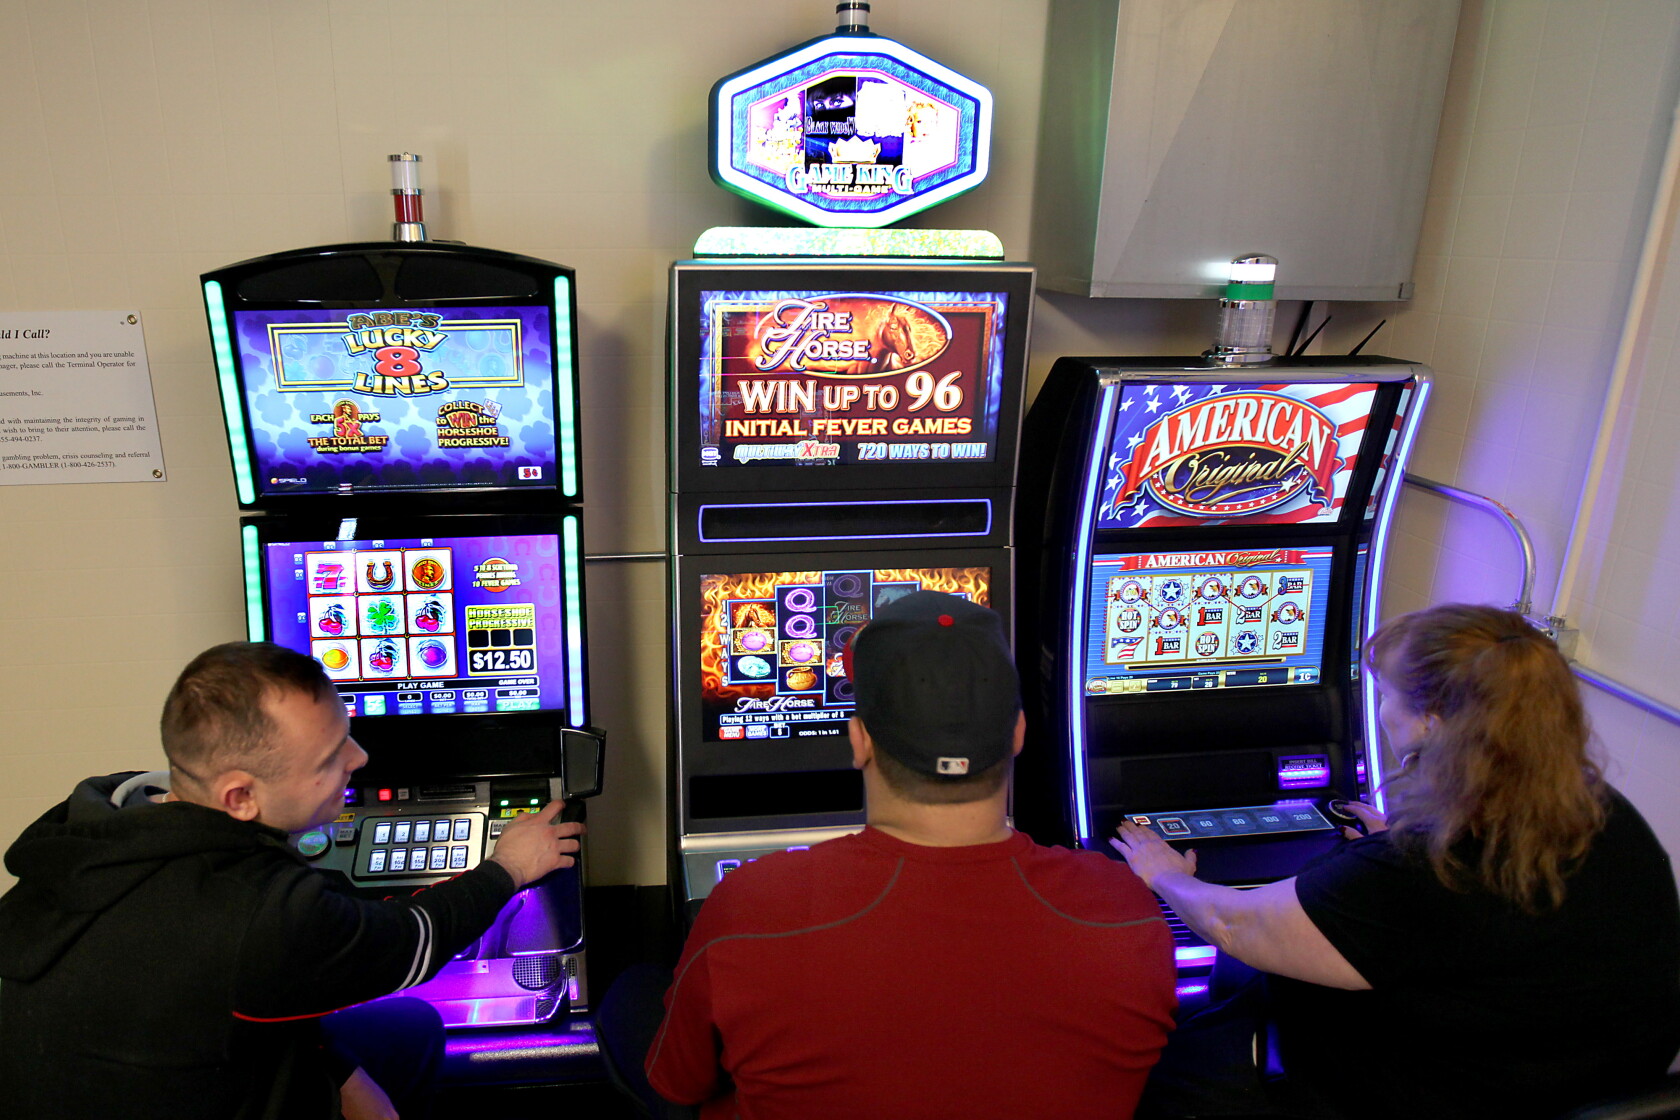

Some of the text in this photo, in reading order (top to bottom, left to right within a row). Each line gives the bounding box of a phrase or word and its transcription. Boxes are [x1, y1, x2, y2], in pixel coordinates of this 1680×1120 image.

[786, 163, 914, 194] GAME KING
[350, 312, 441, 330] ABE'S
[773, 298, 852, 334] FIRE
[0, 329, 50, 340] ld I Call?
[345, 328, 448, 353] LUCKY
[2, 352, 29, 360] machine
[50, 351, 76, 359] location
[113, 350, 135, 358] unable
[755, 327, 871, 371] HORSE
[19, 362, 40, 370] please
[96, 360, 125, 369] Operator
[375, 346, 422, 377] 8
[353, 371, 450, 395] LINES
[737, 371, 963, 414] WIN UP TO 96
[438, 400, 485, 415] COLLECT
[75, 416, 101, 424] integrity
[436, 411, 496, 428] to WIN the
[725, 417, 973, 437] INITIAL FEVER GAMES
[101, 425, 121, 433] please
[437, 427, 498, 436] HORSESHOE
[1140, 397, 1331, 477] AMERICAN
[307, 436, 389, 446] THE TOTAL BET
[438, 437, 510, 447] PROGRESSIVE!
[2, 454, 31, 462] gambling
[32, 453, 61, 461] problem,
[80, 452, 113, 460] counseling
[858, 442, 987, 460] 720 WAYS TO WIN!
[2, 462, 59, 470] 1-800-GAMBLER
[1164, 441, 1310, 503] Original
[1144, 548, 1280, 569] AMERICAN Original
[1278, 576, 1303, 595] 3 BAR
[468, 607, 533, 619] HORSESHOE
[1121, 611, 1138, 620] HOT
[1197, 607, 1221, 626] 1 BAR
[1236, 605, 1261, 624] 2 BAR
[468, 618, 533, 629] PROGRESSIVE
[1119, 620, 1138, 630] SPIN
[1155, 636, 1180, 655] 1 BAR
[1200, 634, 1216, 644] HOT
[1272, 630, 1298, 650] 2 BAR
[1197, 644, 1215, 653] SPIN
[473, 650, 531, 669] $12.50
[734, 696, 815, 713] FIRE HORSE
[722, 716, 744, 724] Playing
[771, 713, 784, 721] with
